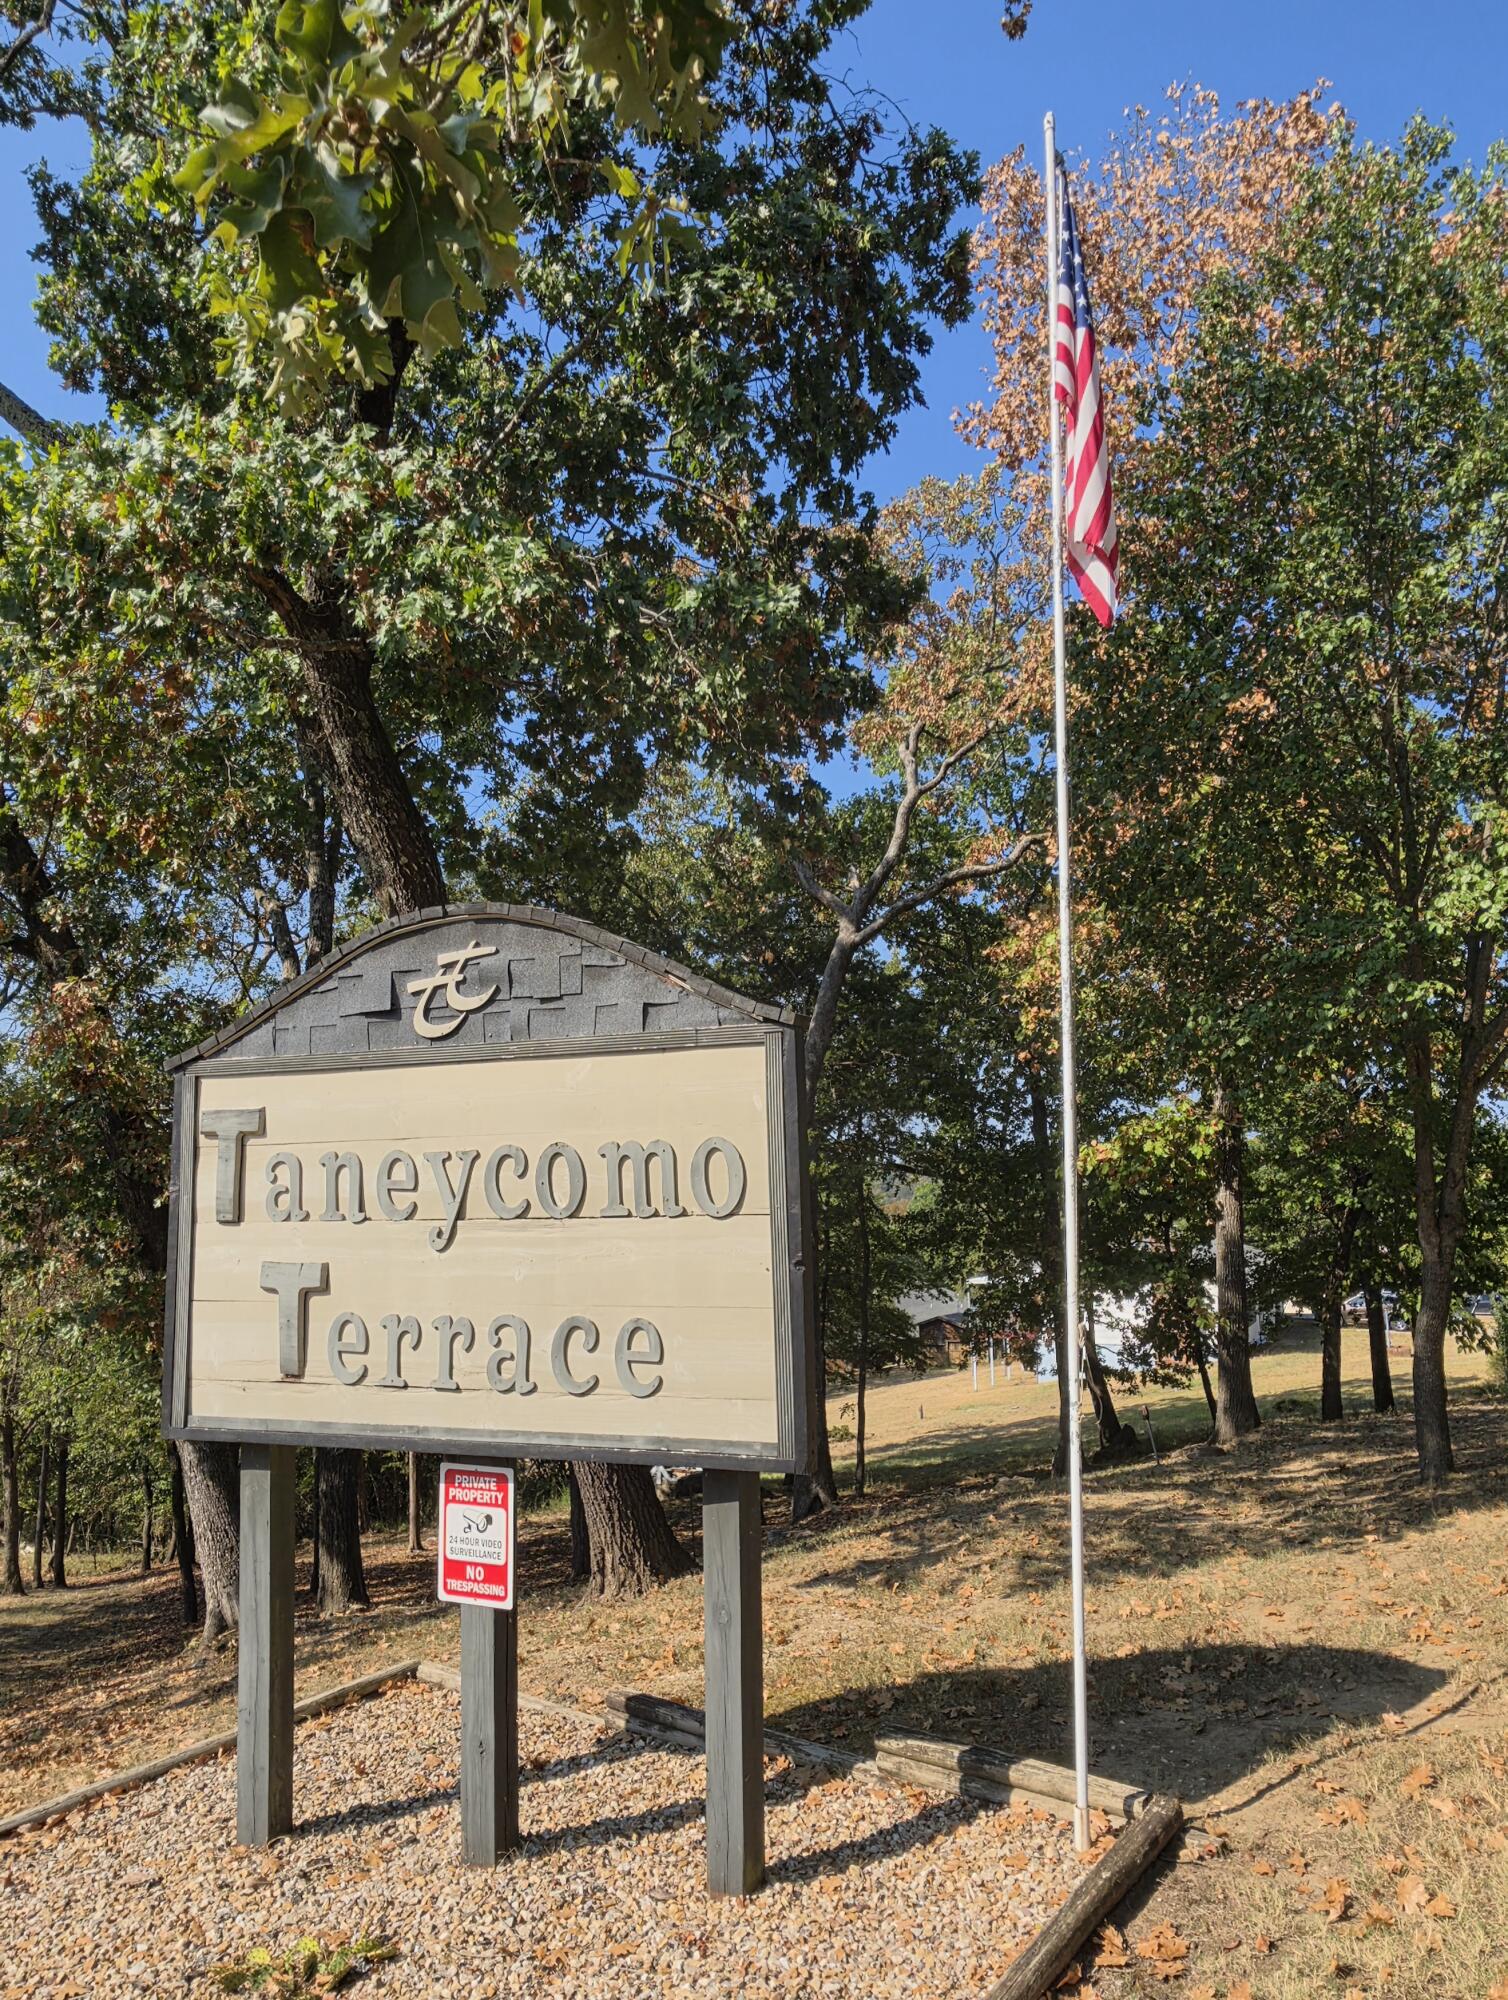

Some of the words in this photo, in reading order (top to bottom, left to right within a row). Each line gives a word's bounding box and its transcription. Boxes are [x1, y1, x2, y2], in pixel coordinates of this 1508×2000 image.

[200, 1106, 748, 1253] Taneycomo
[259, 1261, 664, 1398] Terrace
[455, 1474, 497, 1490] PRIVATE
[449, 1488, 504, 1505] PROPERTY
[449, 1535, 458, 1545] 24
[459, 1537, 480, 1547] HOUR
[481, 1538, 502, 1549] VIDEO
[449, 1546, 502, 1560] SURVEILLANCE
[466, 1565, 485, 1581] NO
[446, 1579, 505, 1596] TRESPASSING
